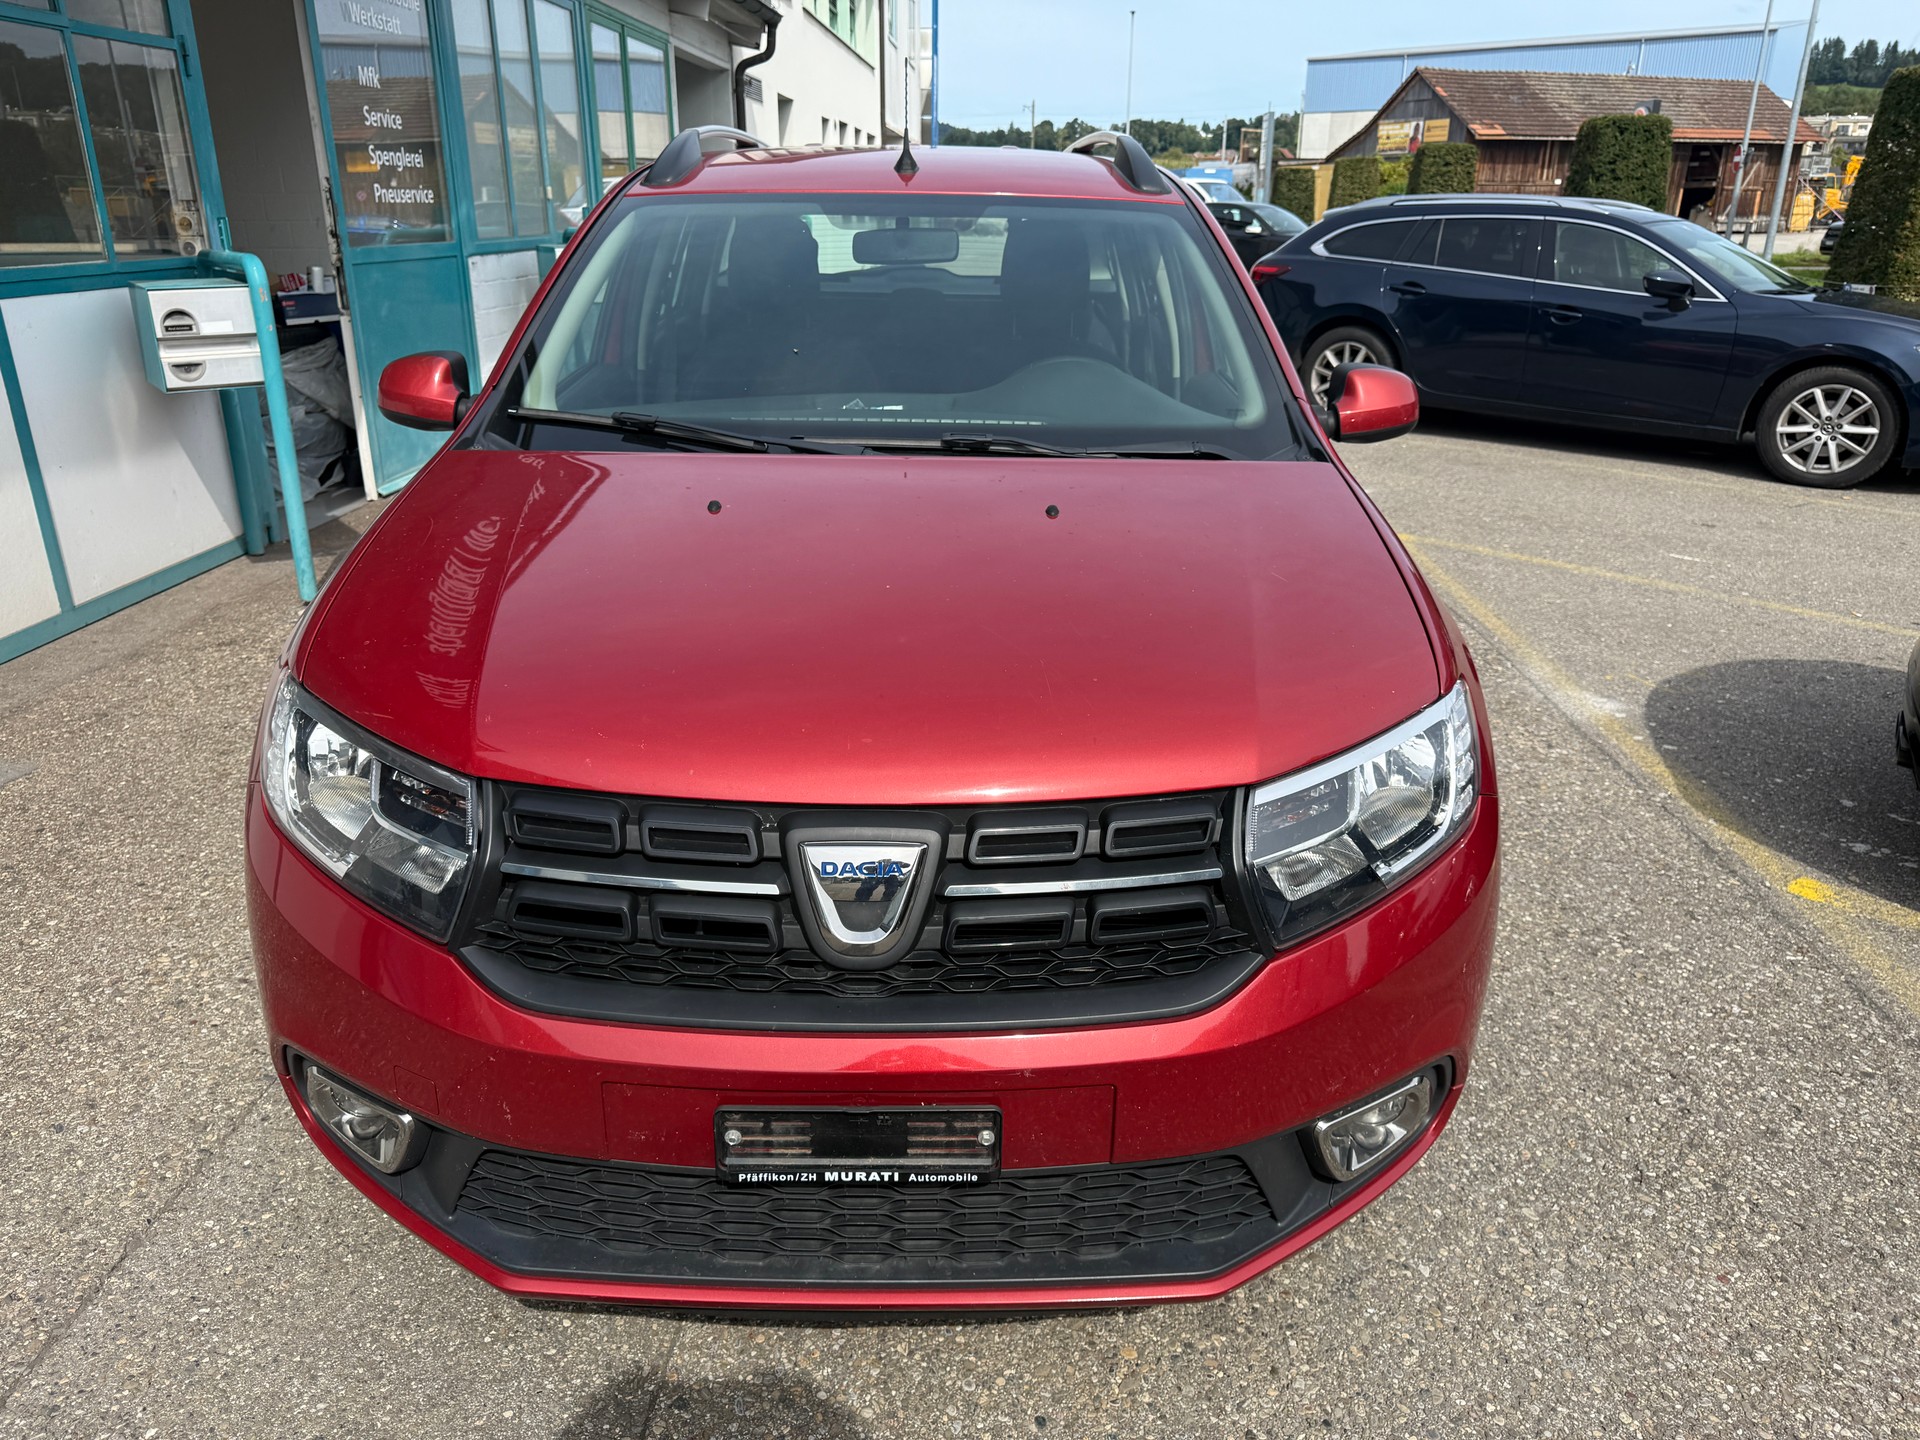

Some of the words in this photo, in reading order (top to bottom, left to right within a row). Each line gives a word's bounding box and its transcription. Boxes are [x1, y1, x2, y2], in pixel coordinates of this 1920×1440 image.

[349, 1, 401, 35] Werkstatt
[358, 65, 381, 89] Mfk
[363, 105, 402, 130] Service
[368, 145, 424, 172] Spenglerei
[373, 183, 434, 203] Pneuservice
[820, 861, 905, 878] DACIA
[738, 1172, 817, 1183] Pfäffikon/ZH
[824, 1171, 900, 1182] MURATI
[908, 1172, 978, 1182] Automobile
